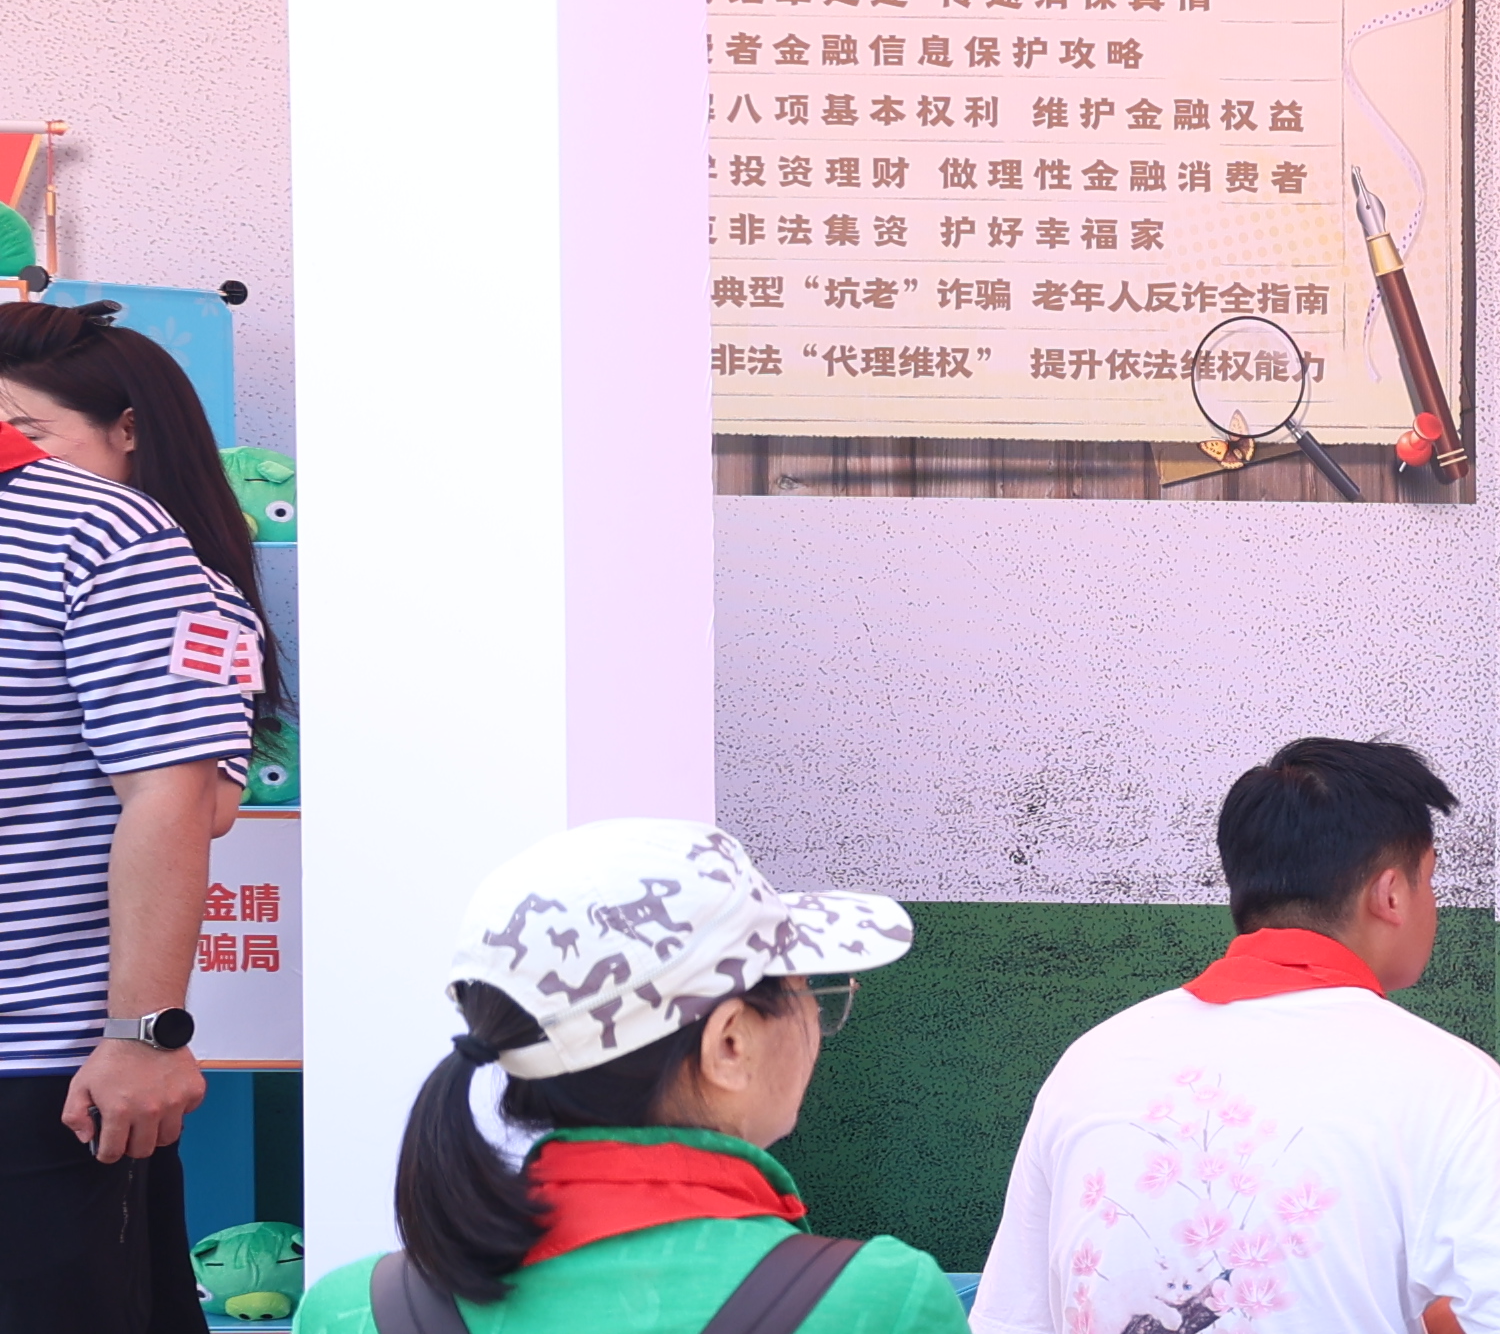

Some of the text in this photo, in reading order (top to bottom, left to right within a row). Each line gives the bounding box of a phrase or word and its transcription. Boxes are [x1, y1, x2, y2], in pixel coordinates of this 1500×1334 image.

[707, 31, 1145, 70] 者金融信息保护攻略
[709, 93, 1305, 133] 八项基本权利 维护金融权益
[709, 153, 1307, 195] 投资理财 做理性金融消费者
[709, 213, 1165, 251] 非法集资 护好幸福家
[1032, 278, 1329, 316] 老年人反诈全指南
[1030, 346, 1326, 384] 提升依法维权能力
[203, 882, 281, 922] 金睛
[198, 932, 280, 972] 骗局
